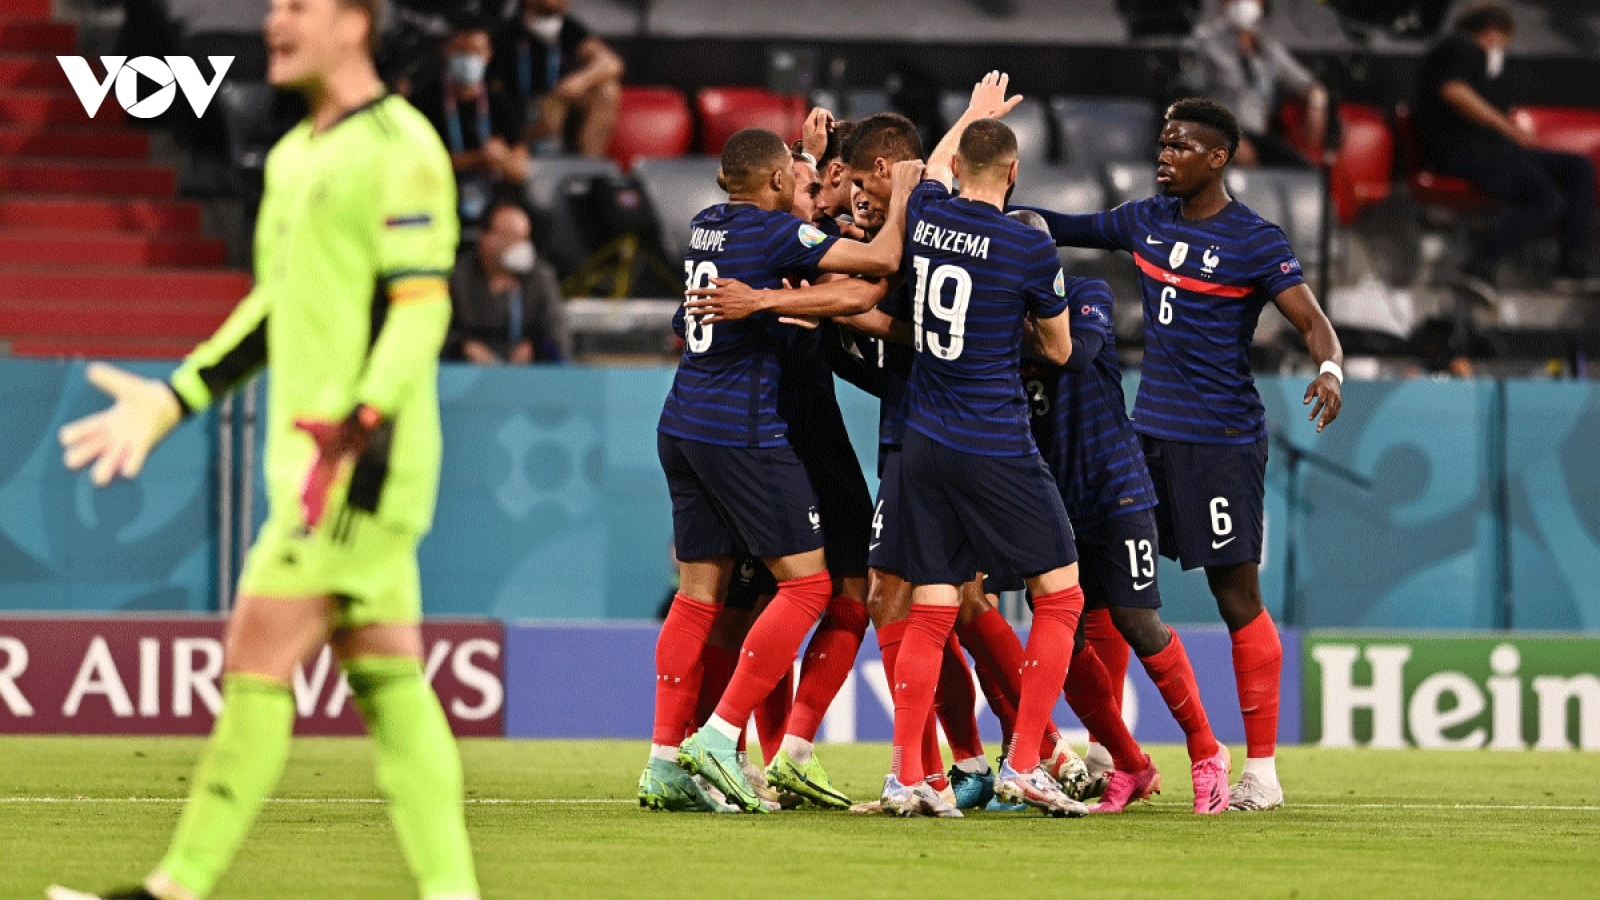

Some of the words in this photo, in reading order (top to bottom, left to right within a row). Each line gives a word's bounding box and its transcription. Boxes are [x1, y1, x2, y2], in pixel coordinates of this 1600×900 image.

[912, 219, 990, 260] BENZEMA
[912, 255, 973, 361] 19
[1158, 286, 1177, 325] 6
[1209, 496, 1233, 536] 6
[1124, 539, 1155, 578] 13
[1311, 644, 1600, 750] Hein
